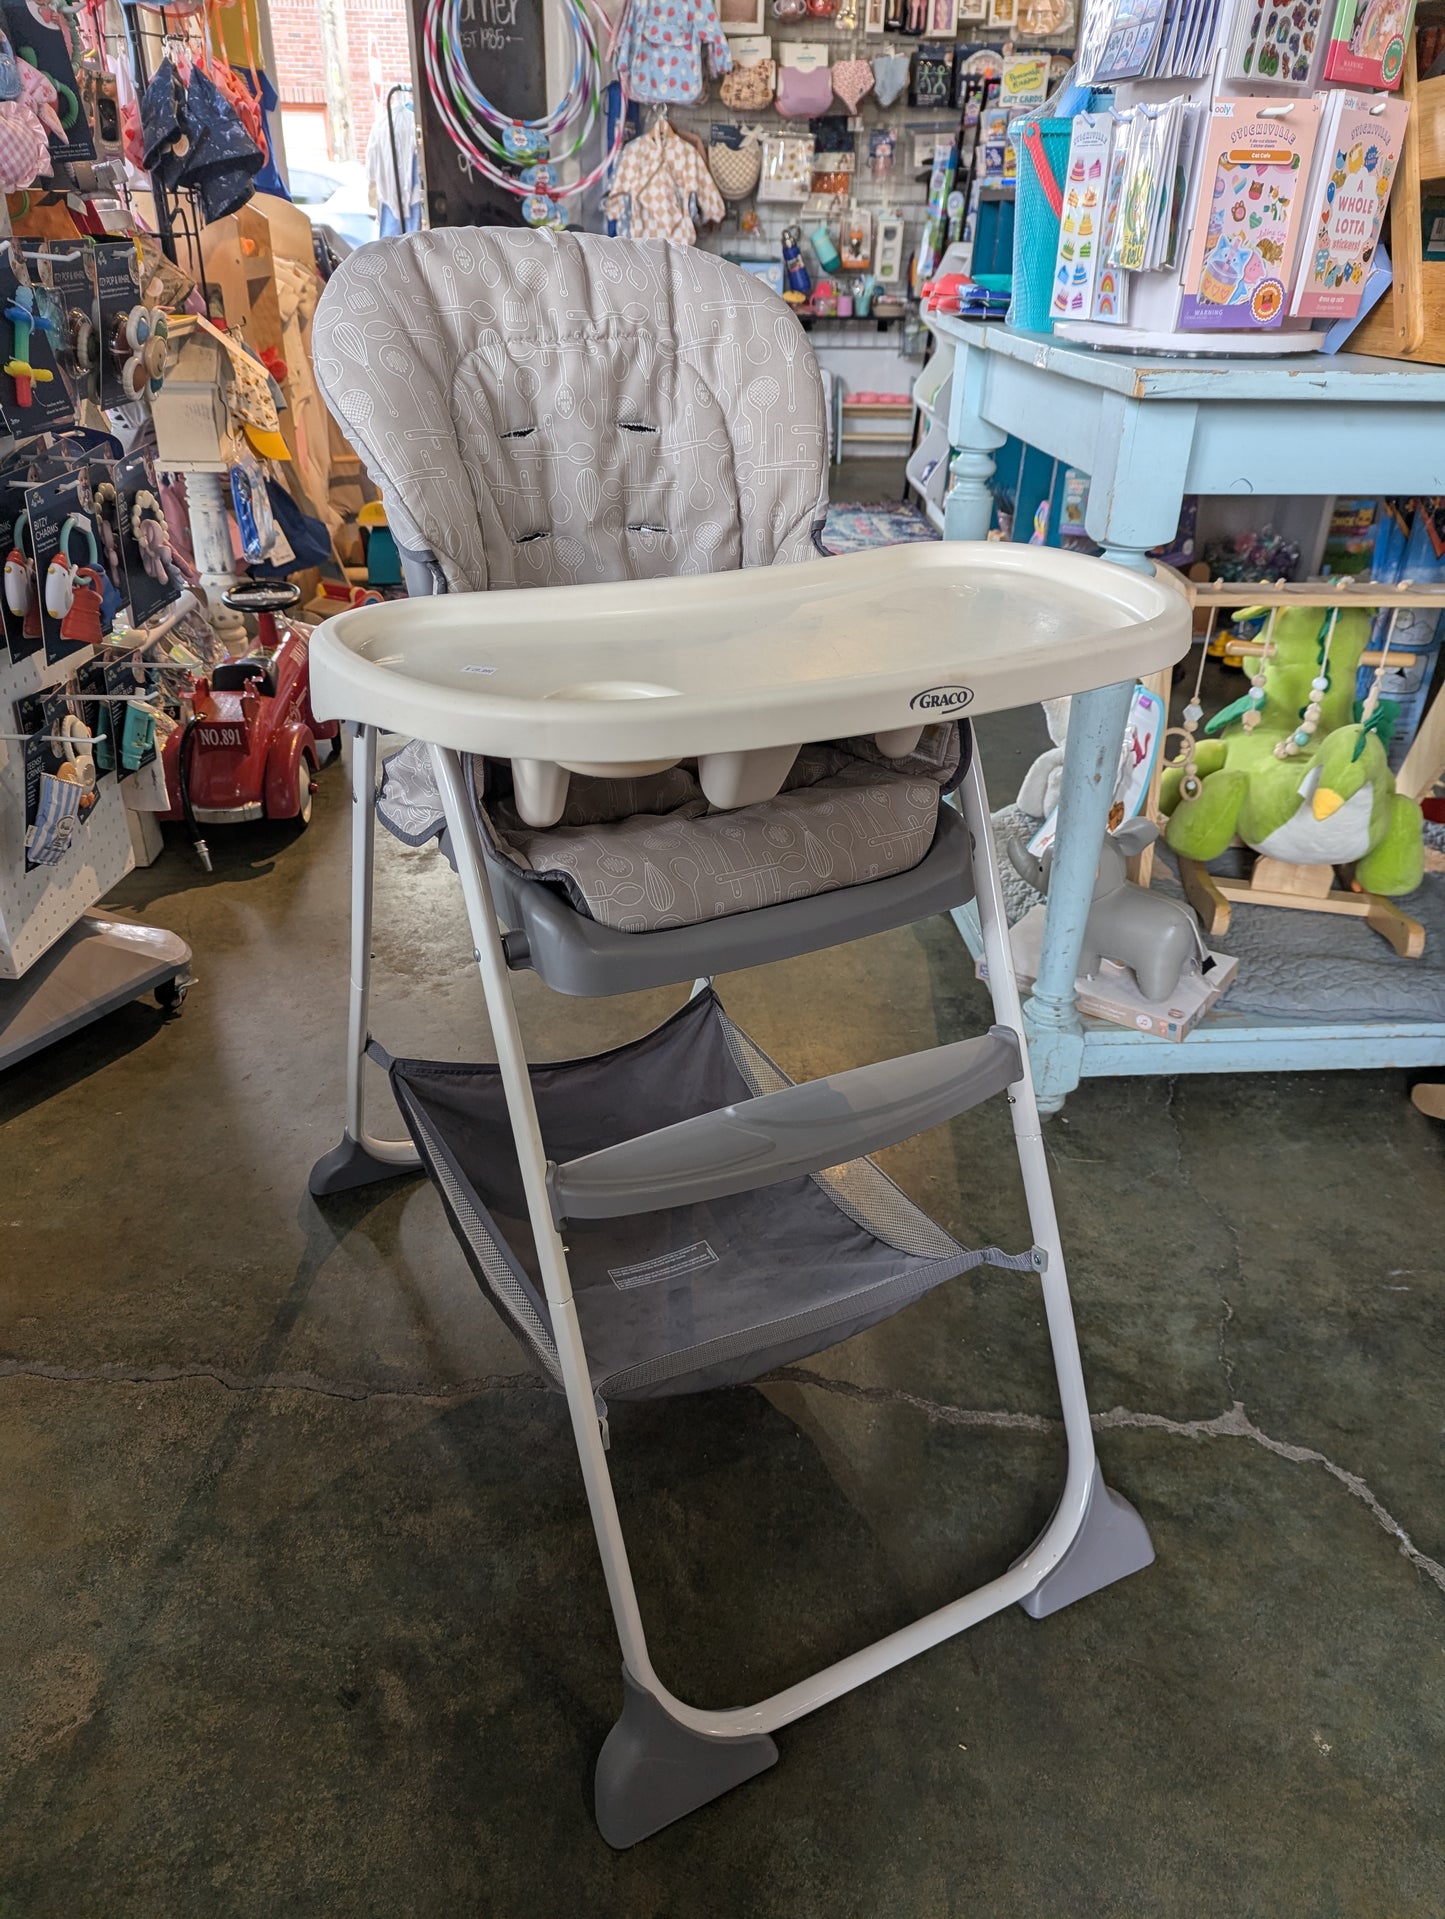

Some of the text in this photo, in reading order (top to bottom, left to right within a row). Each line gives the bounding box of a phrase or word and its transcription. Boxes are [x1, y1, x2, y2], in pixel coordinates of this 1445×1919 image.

[480, 28, 504, 49] 1985
[1020, 95, 1042, 103] CARDS
[1215, 104, 1231, 115] ooly
[1231, 123, 1297, 145] STICKIVILLE
[1357, 180, 1363, 192] A
[1338, 196, 1374, 215] WHOLE
[1335, 218, 1365, 236] LOTTA
[1331, 237, 1360, 252] stickers!
[33, 516, 48, 530] BITZY
[35, 523, 58, 540] CHARMS
[919, 691, 968, 709] GRACO
[199, 728, 242, 746] NO.891
